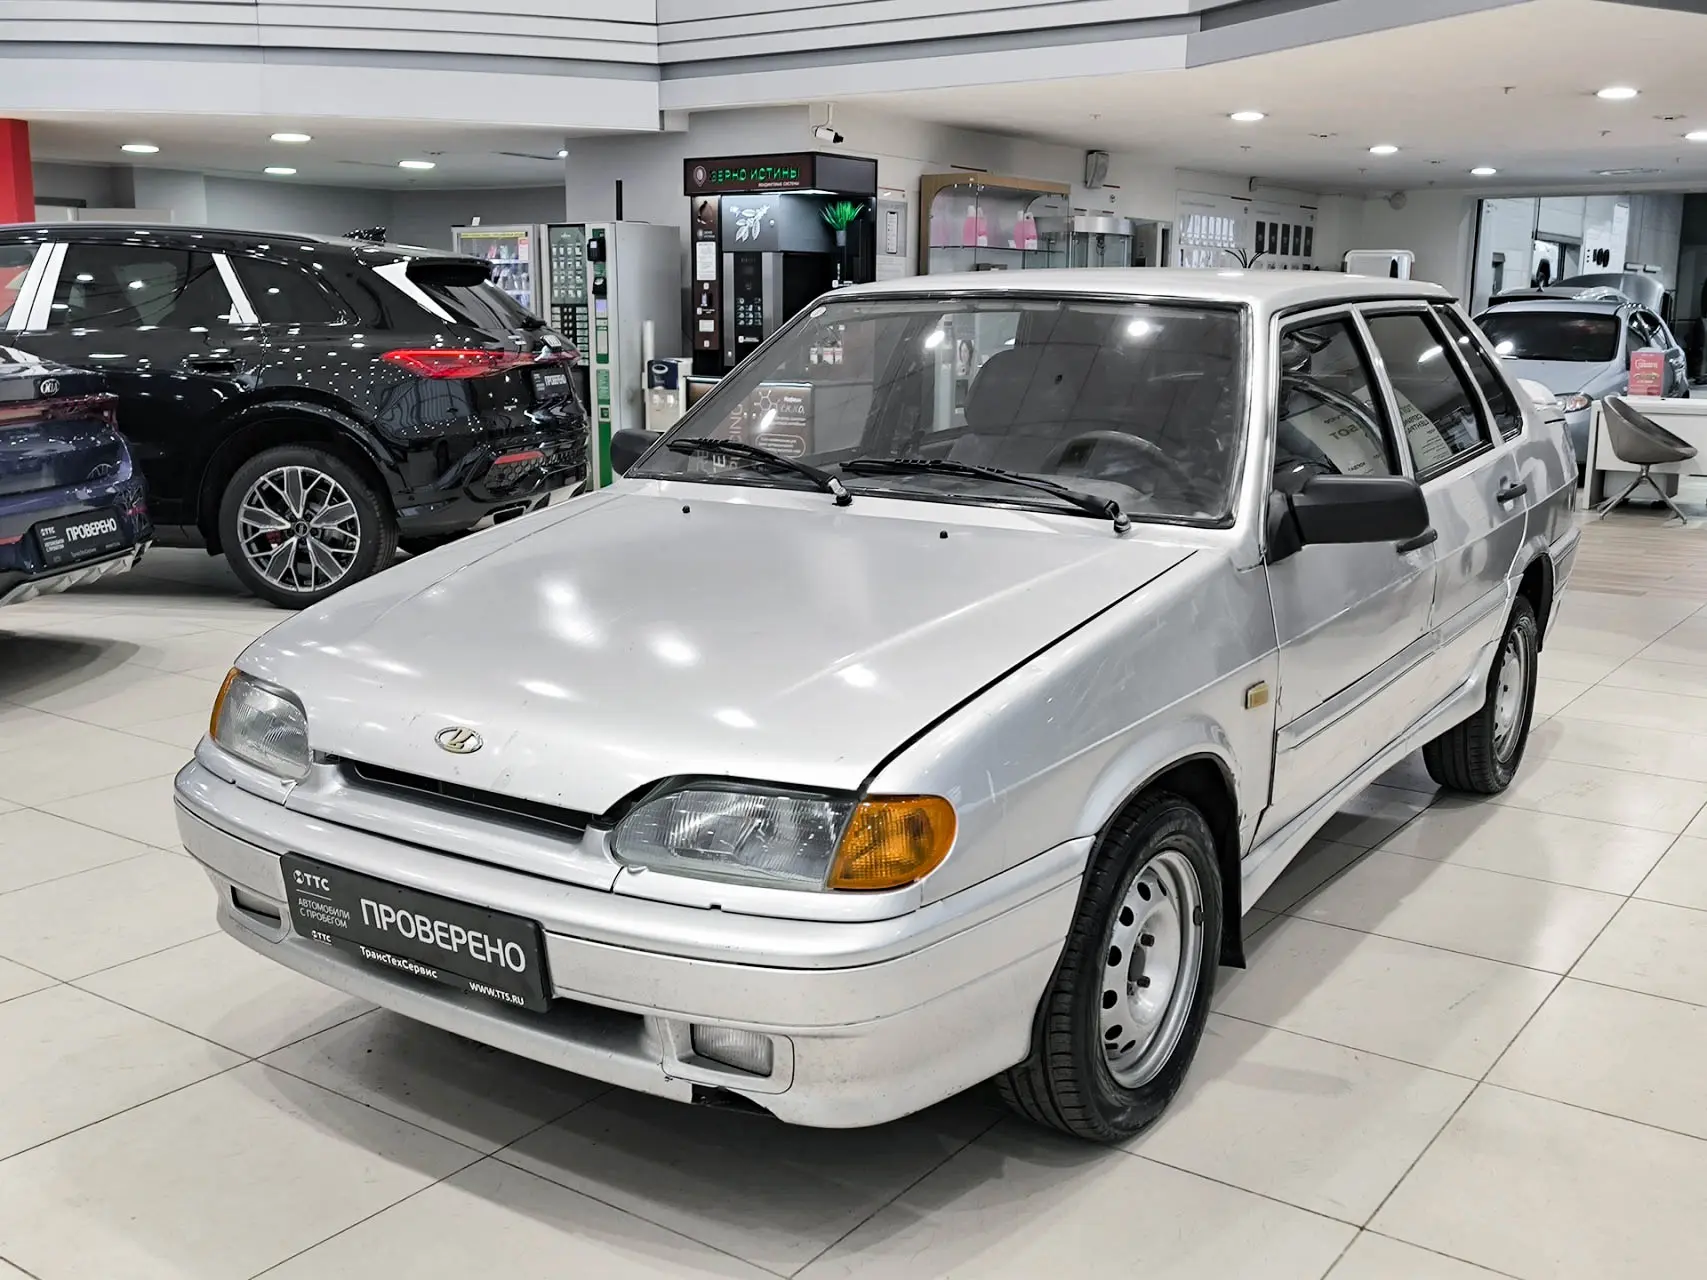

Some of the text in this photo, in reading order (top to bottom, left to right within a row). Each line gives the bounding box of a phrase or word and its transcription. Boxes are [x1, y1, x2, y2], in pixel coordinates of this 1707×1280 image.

[710, 167, 800, 183] ЗЕРНО ИСТИНЫ
[66, 518, 117, 541] ПРОВЕРЕНО
[303, 872, 330, 891] ТТС
[298, 898, 350, 920] АВТОМОБИЛИ
[300, 907, 348, 929] С ПРОБЕГОМ
[360, 898, 526, 973] ПРОВЕРЕНО
[359, 945, 438, 979] ТрансТехСервис
